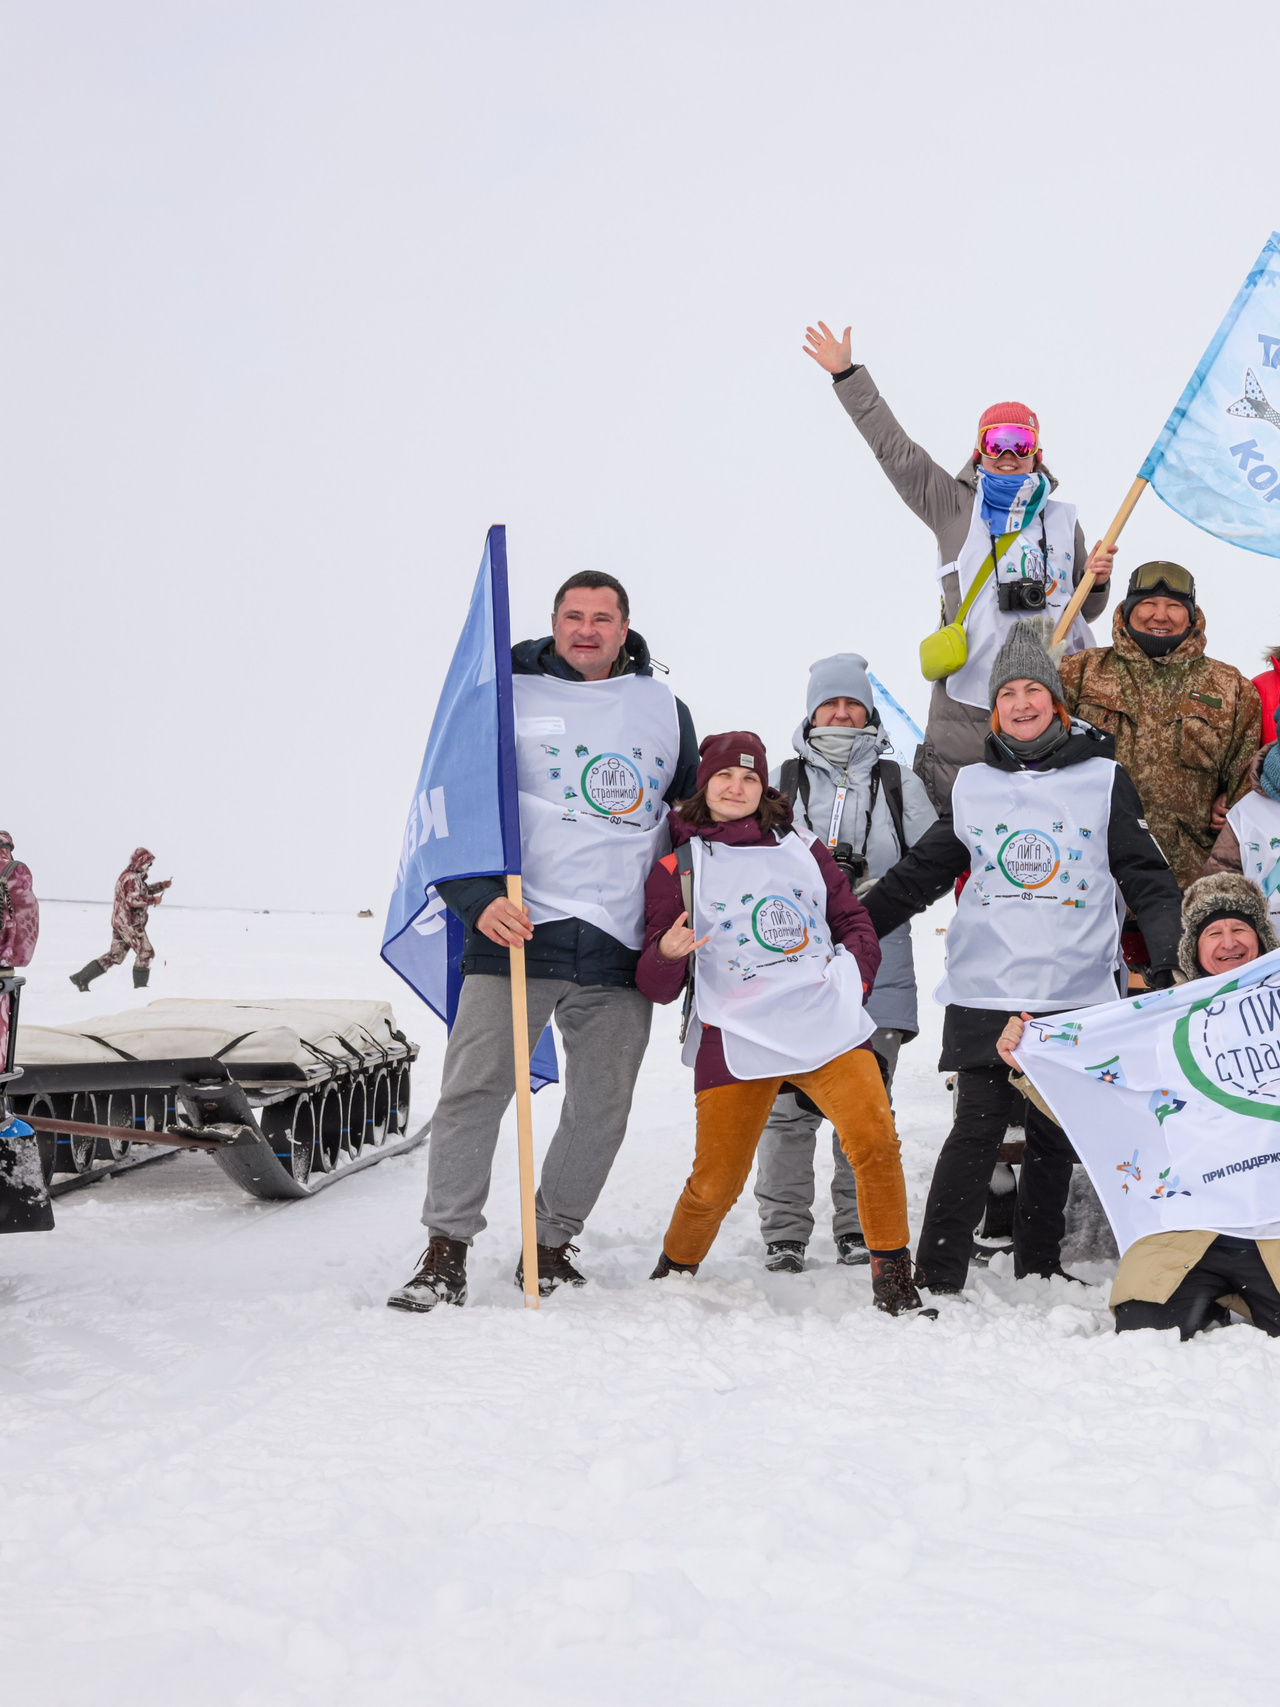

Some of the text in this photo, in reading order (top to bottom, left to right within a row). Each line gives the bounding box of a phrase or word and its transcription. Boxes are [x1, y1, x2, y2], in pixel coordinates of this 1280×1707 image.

[602, 770, 626, 786] ЛИГА
[1017, 844, 1041, 860] ЛИГА
[770, 910, 794, 926] ЛИГА
[1202, 1168, 1226, 1184] ПРИ
